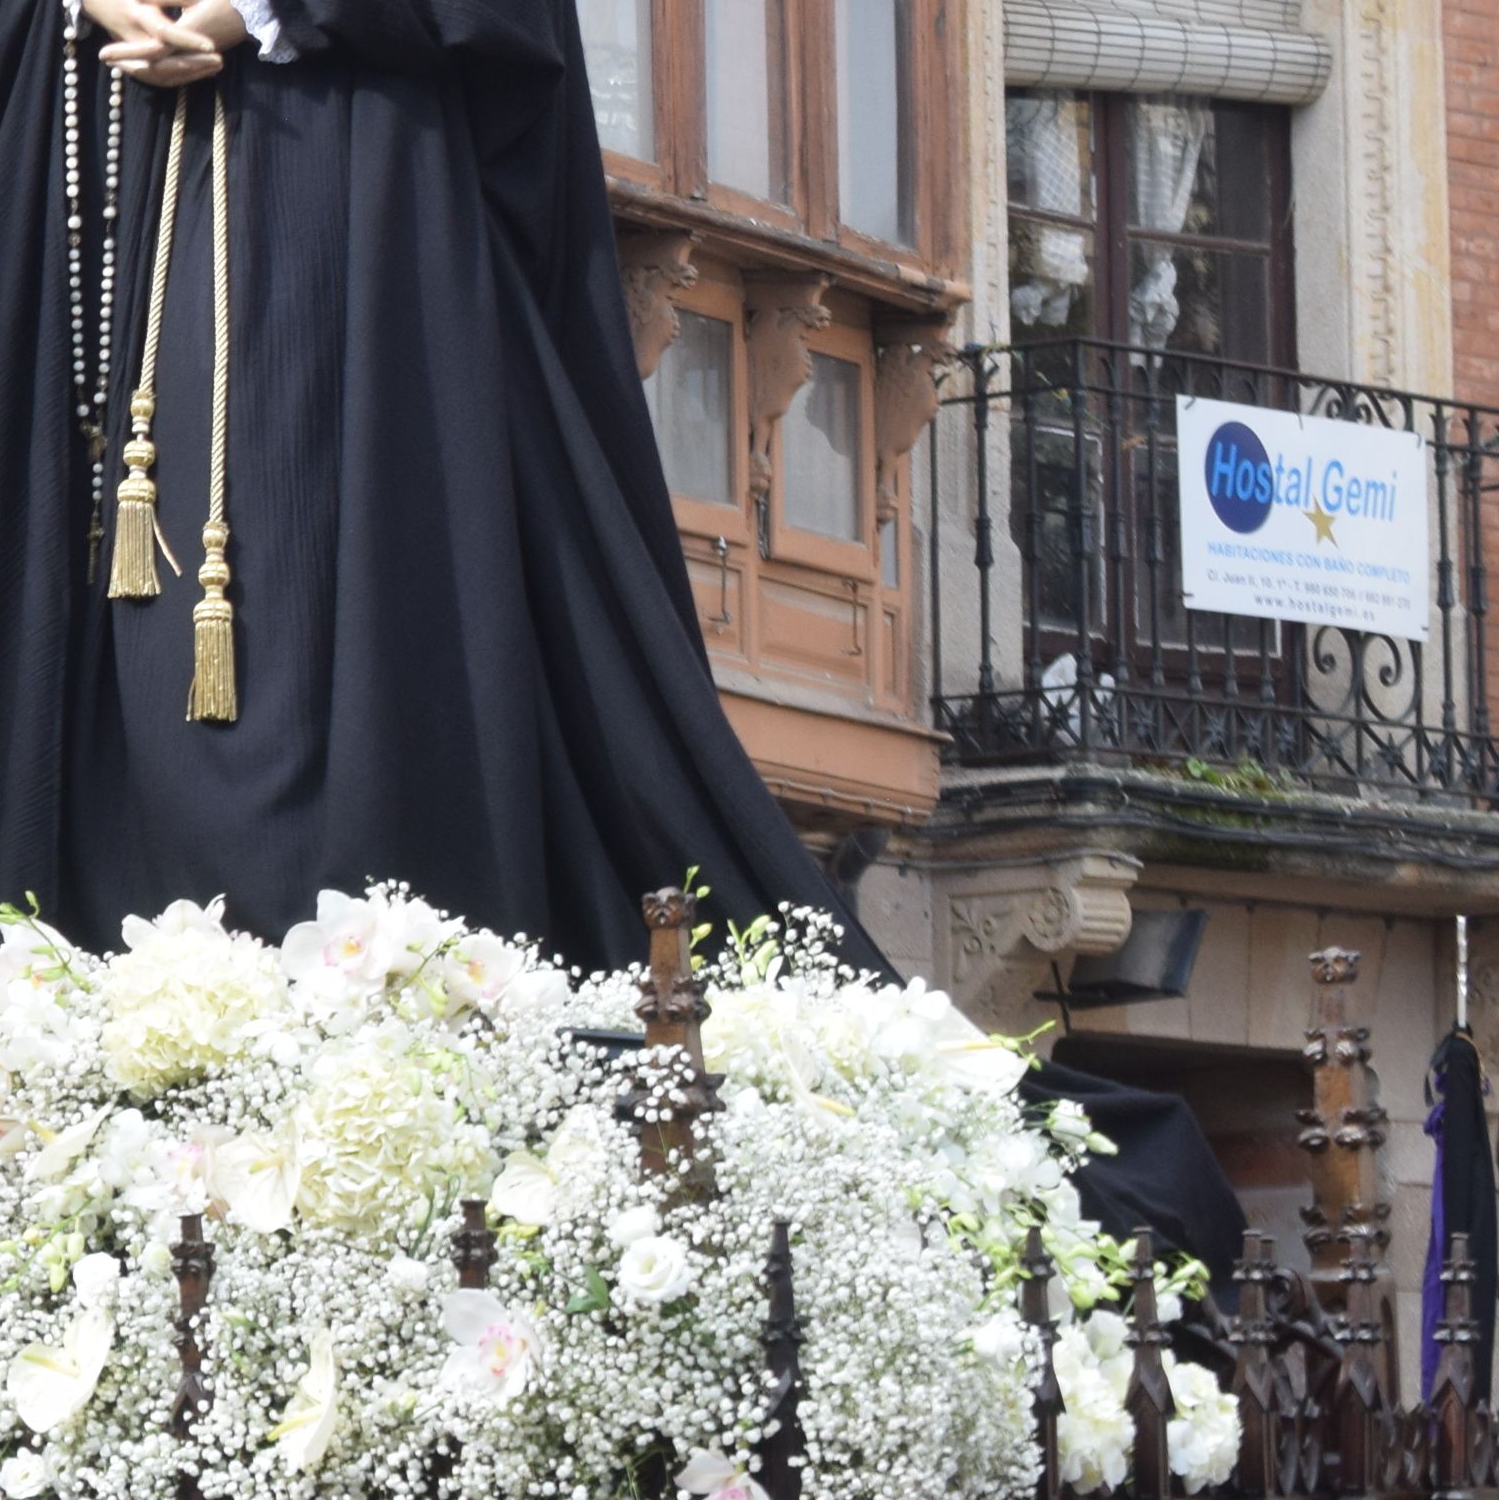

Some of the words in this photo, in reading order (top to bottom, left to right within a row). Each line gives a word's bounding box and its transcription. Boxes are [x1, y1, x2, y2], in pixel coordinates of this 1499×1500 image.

[1210, 440, 1312, 507] Hostal
[1322, 459, 1397, 522] Gemi
[1207, 541, 1293, 566] HABITACIONES
[1296, 552, 1321, 569] CON
[1356, 561, 1410, 585] COMPLETO
[1253, 593, 1376, 622] www.hostalgemi.es
